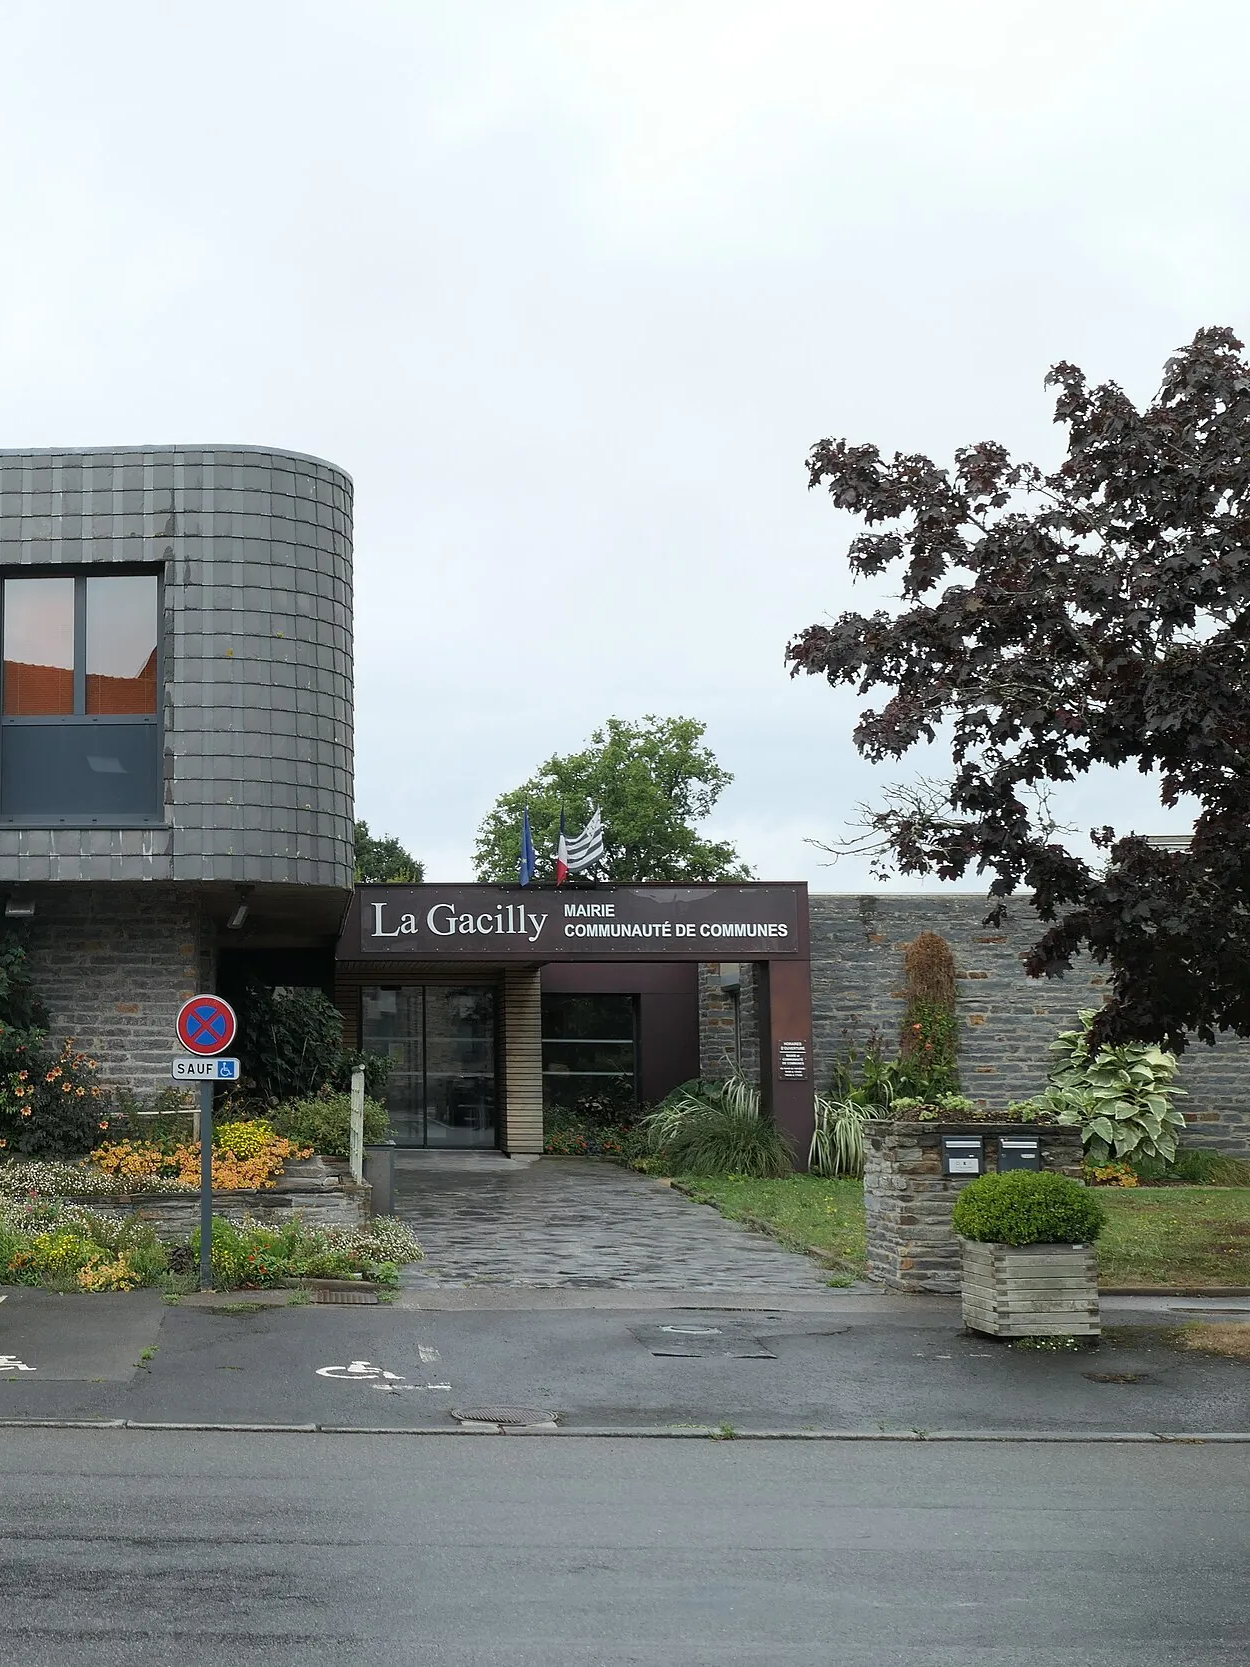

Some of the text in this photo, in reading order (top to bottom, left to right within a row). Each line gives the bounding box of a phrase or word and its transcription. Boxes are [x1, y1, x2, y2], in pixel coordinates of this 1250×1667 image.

[564, 904, 615, 917] MAIRIE
[371, 902, 549, 942] La Gacilly
[564, 921, 789, 938] COMMUNAUTÉ DE COMMUNES
[177, 1063, 214, 1075] SAUF
